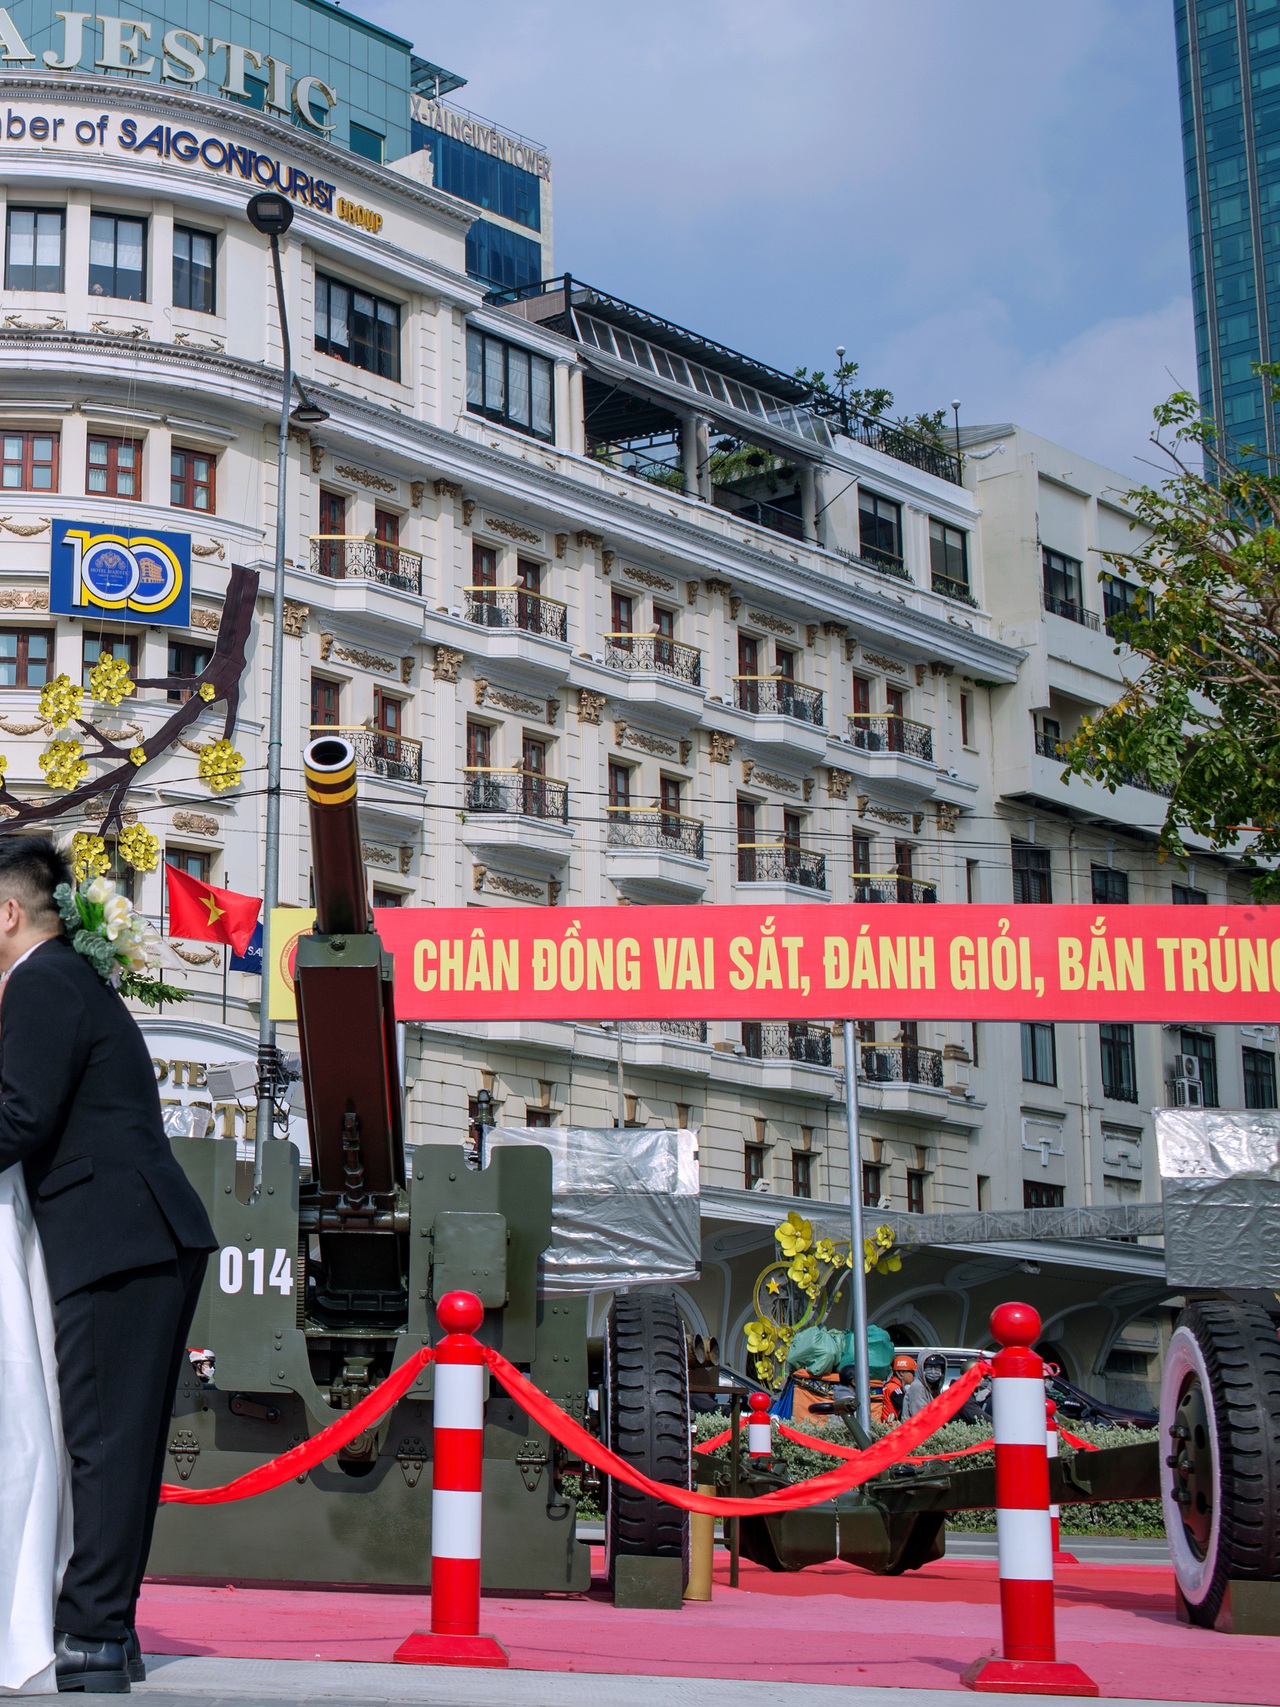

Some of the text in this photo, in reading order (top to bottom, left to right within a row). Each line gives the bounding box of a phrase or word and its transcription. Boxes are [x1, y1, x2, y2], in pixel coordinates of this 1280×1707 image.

[75, 115, 109, 147] of
[118, 118, 336, 213] SAIGONTOURIST
[337, 196, 383, 233] GROUP
[450, 113, 505, 162] NGUYÊN
[506, 141, 551, 182] TOWER
[62, 529, 183, 613] 100
[414, 928, 519, 992] CHÂN
[532, 920, 640, 992] ĐỒNG
[654, 937, 714, 990] VAI
[729, 915, 810, 997] SẮT,
[823, 924, 935, 990] ĐÁNH
[950, 918, 1044, 998] GIỎI,
[1058, 916, 1144, 991] BẮN
[220, 1246, 294, 1296] 014
